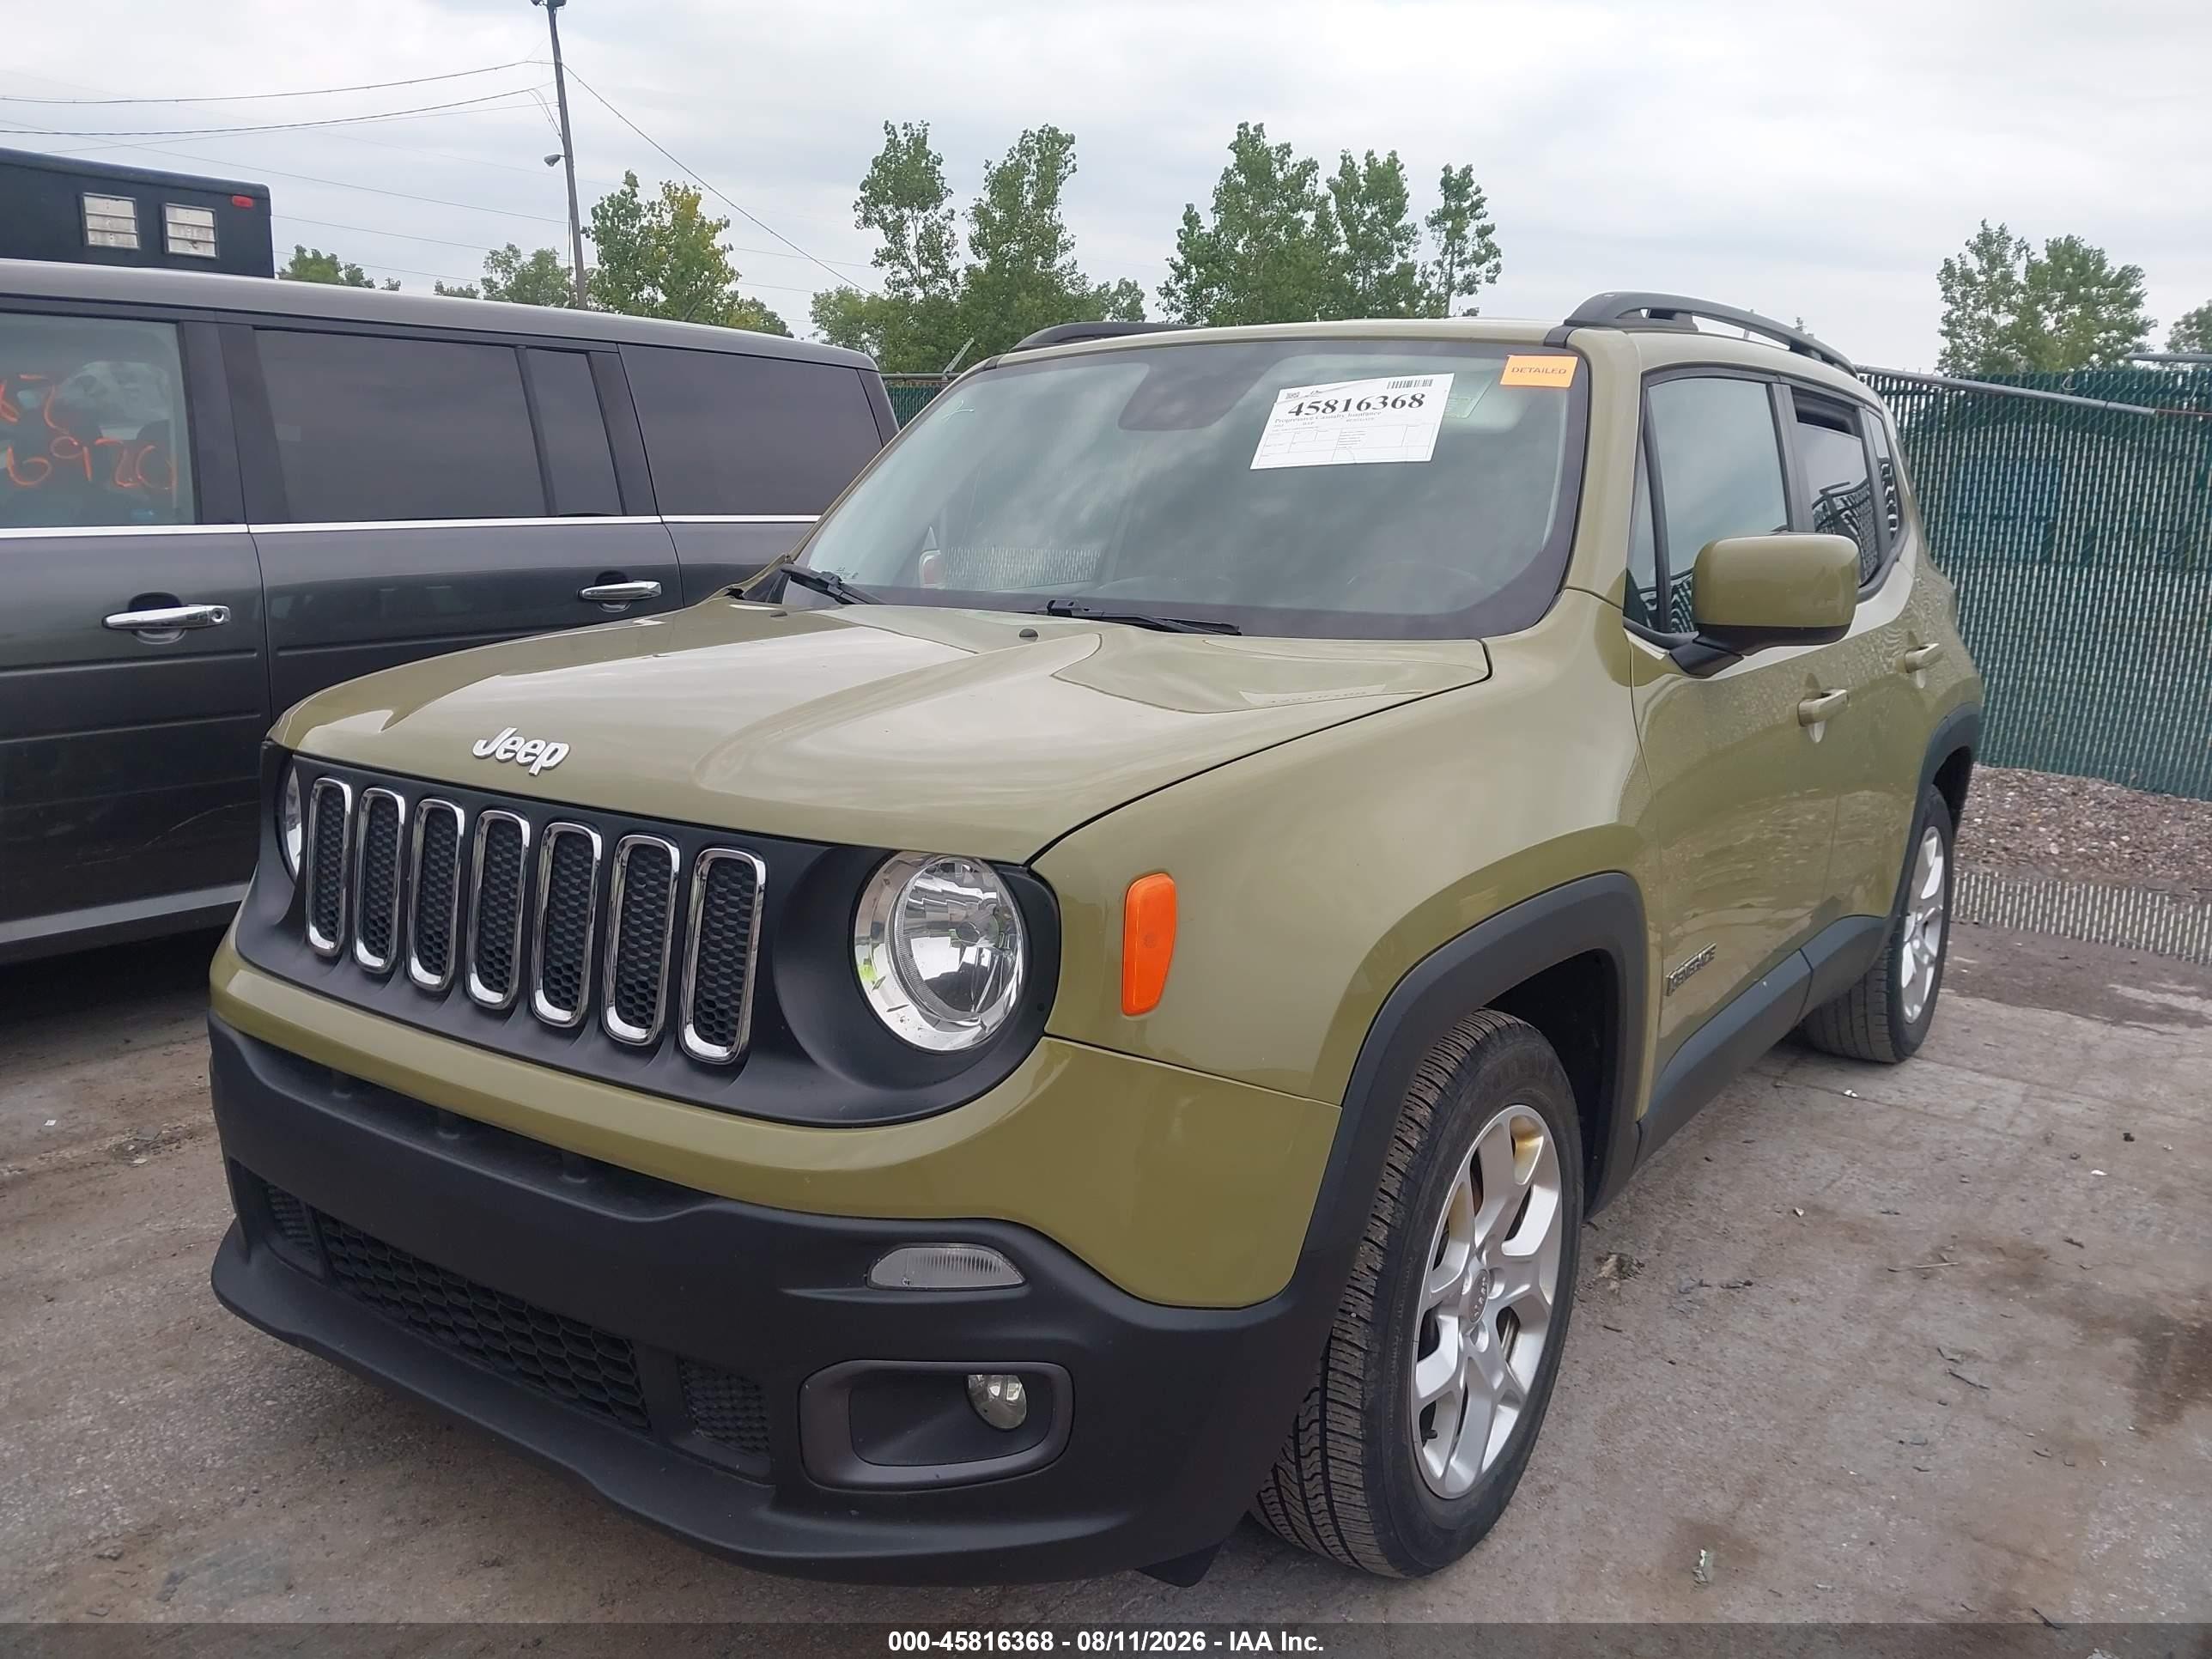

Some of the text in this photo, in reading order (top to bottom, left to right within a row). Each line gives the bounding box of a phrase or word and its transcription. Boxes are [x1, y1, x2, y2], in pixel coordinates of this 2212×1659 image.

[1510, 366, 1567, 375] DETAILED
[1288, 392, 1425, 416] 45816368
[472, 726, 570, 776] Jeep
